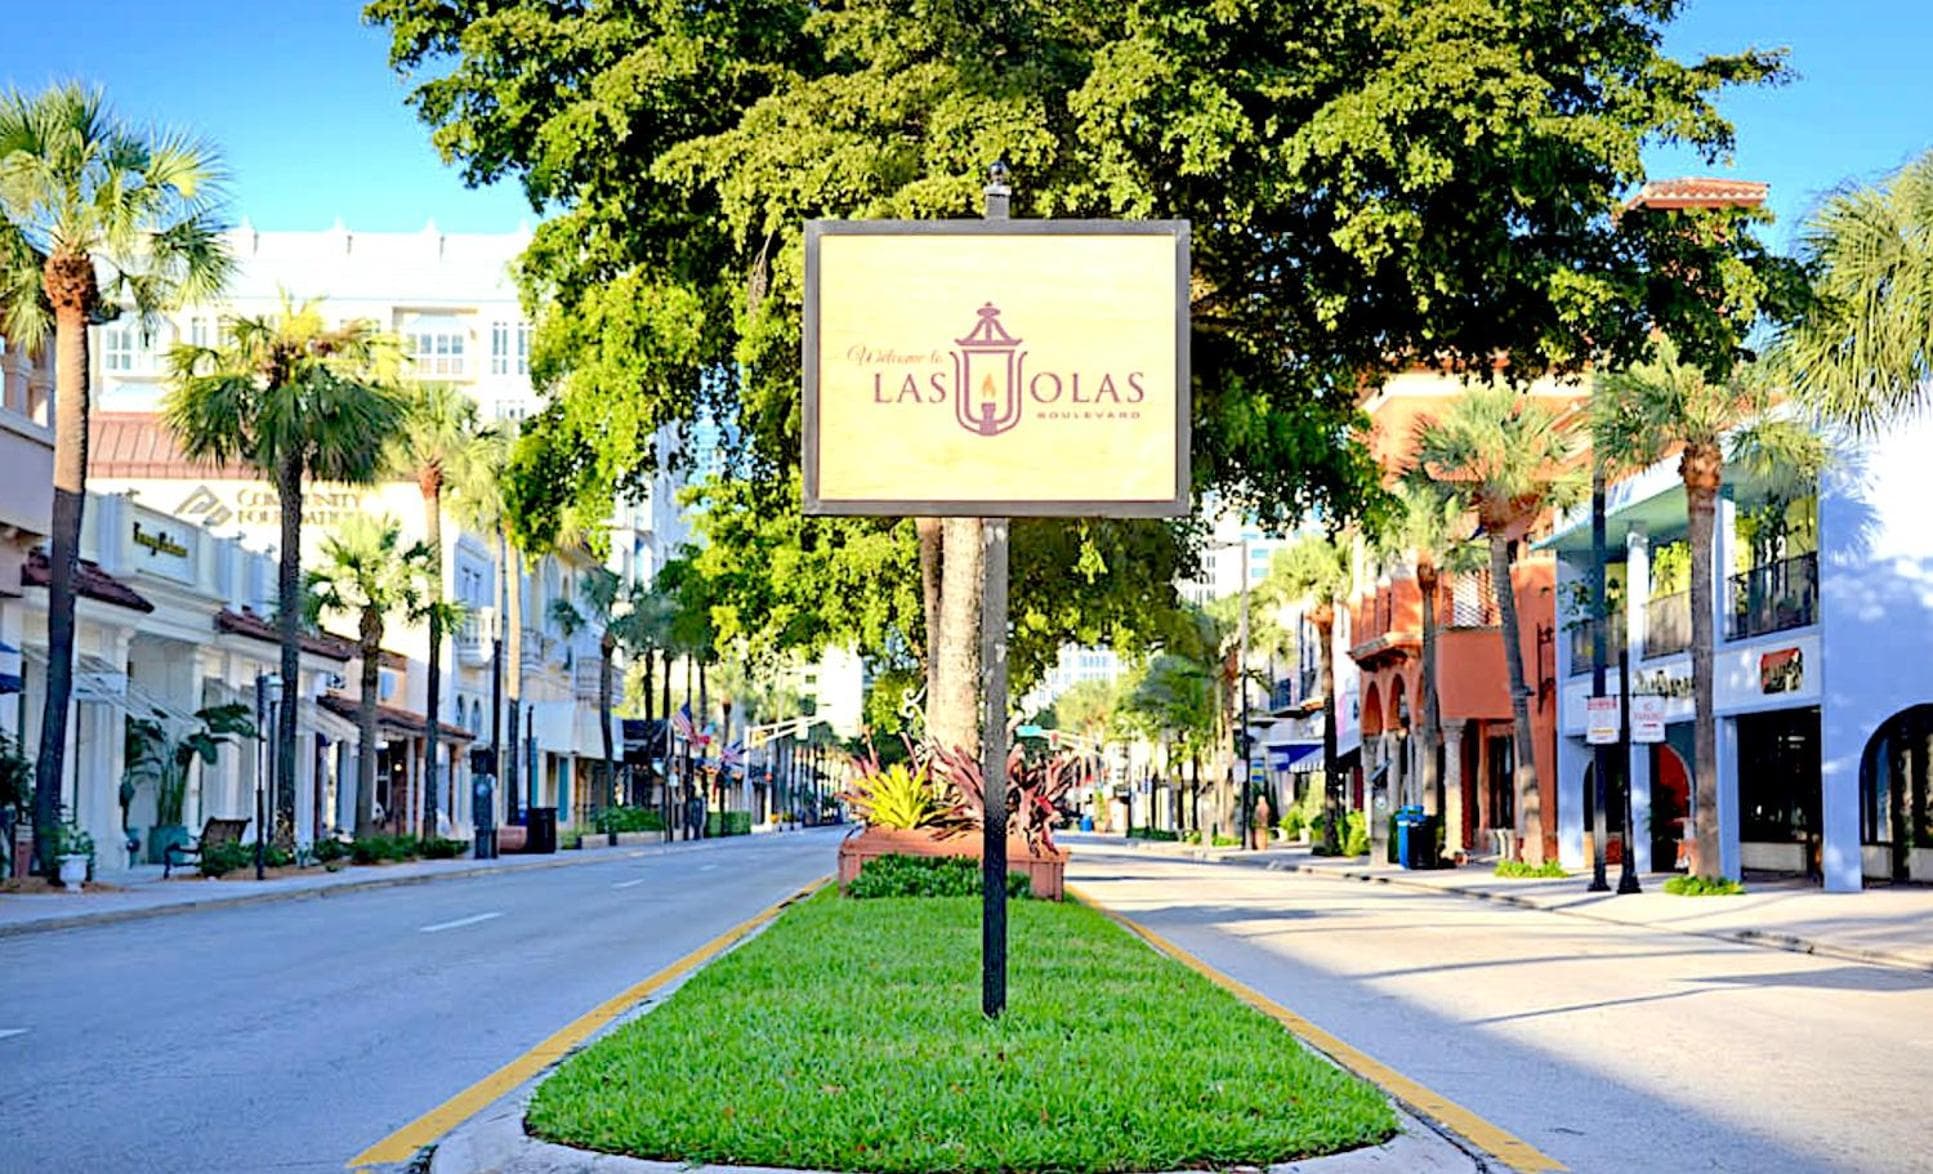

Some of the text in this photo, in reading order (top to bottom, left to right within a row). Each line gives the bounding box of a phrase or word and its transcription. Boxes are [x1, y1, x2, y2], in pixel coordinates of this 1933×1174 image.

[847, 343, 944, 366] Welcome to
[874, 371, 1145, 404] LAS OLAS
[1036, 410, 1141, 420] BOULEVARD
[236, 488, 361, 507] COMNITY
